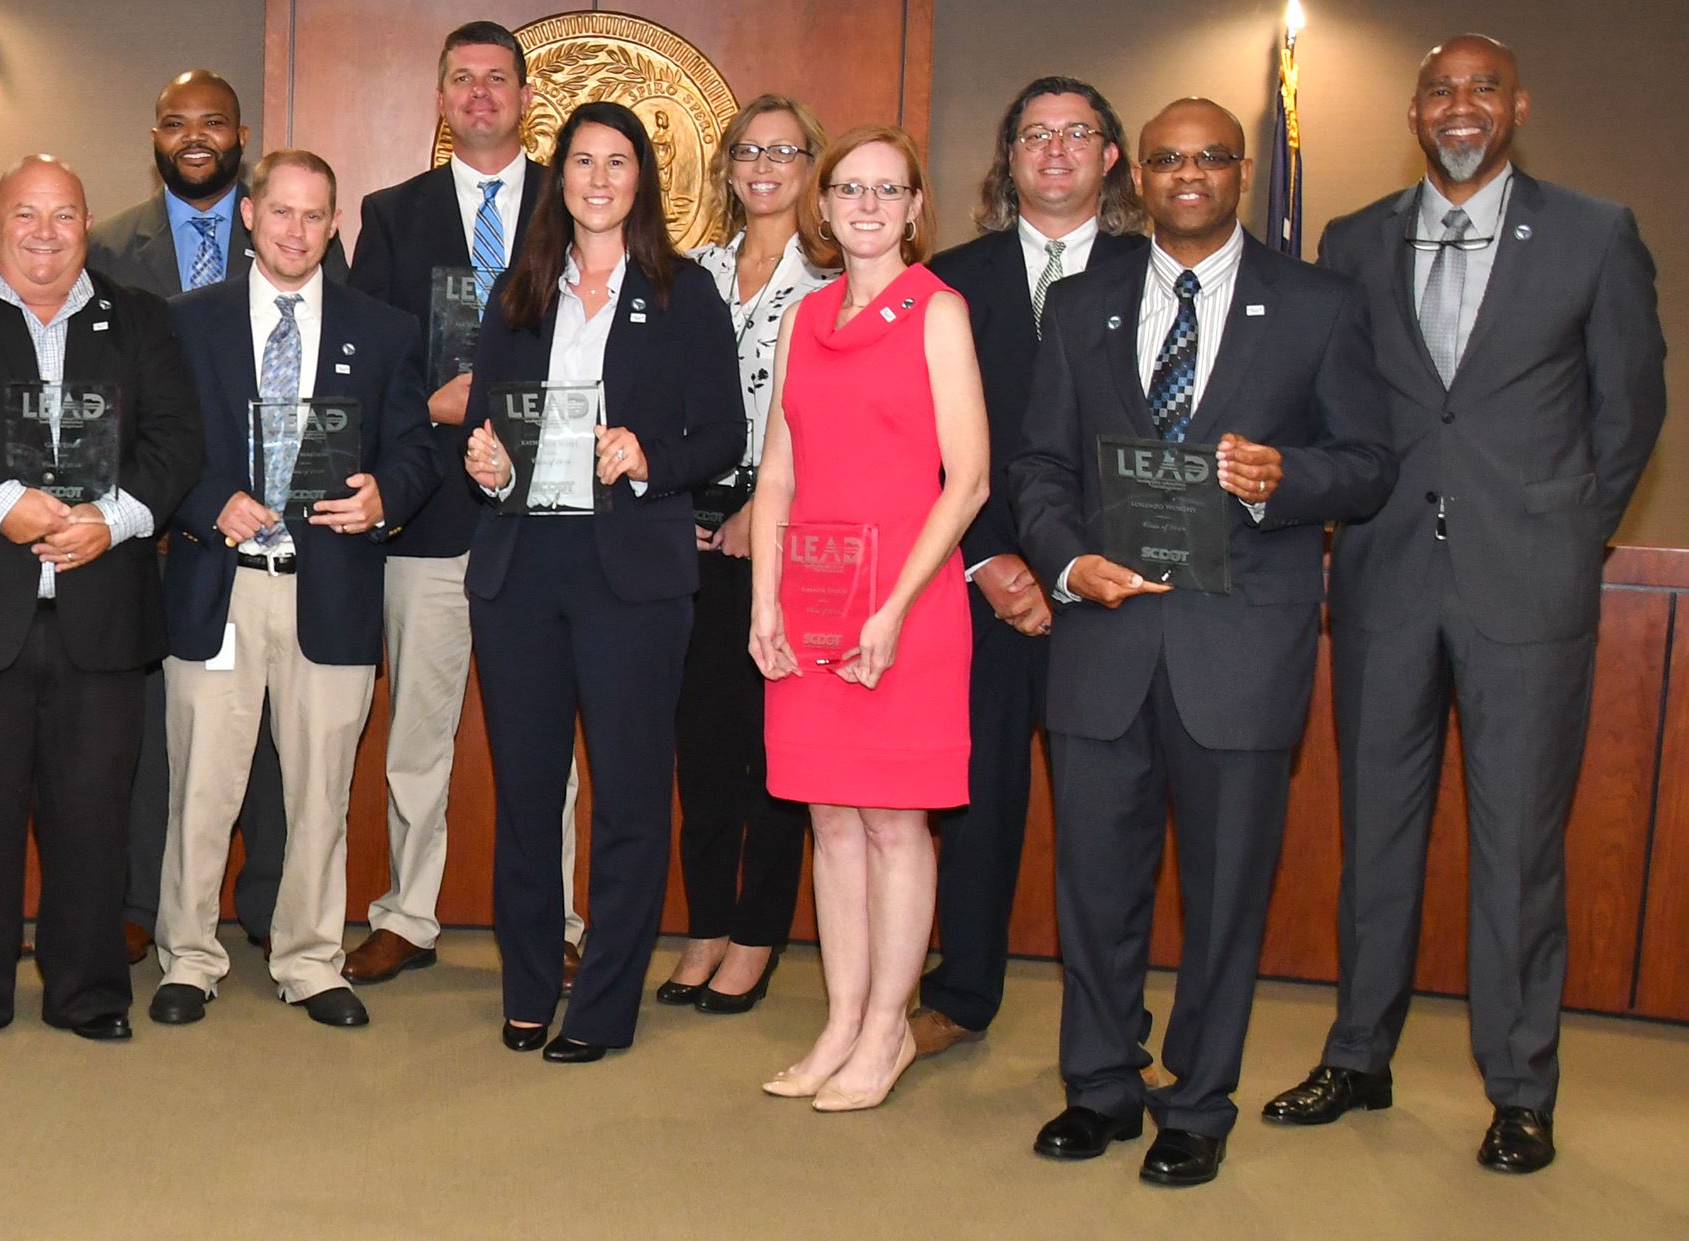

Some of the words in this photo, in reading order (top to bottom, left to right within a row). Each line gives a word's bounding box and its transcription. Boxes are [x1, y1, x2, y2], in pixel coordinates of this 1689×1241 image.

[628, 82, 678, 101] SPIRO
[683, 93, 714, 144] SPERO
[21, 392, 106, 420] LEAD
[506, 392, 590, 420] LEAD
[1117, 449, 1210, 485] LEAD
[695, 511, 724, 523] CDOT
[791, 535, 863, 564] LEAD
[1141, 546, 1190, 562] SCDOT
[804, 633, 842, 647] SCDOT
